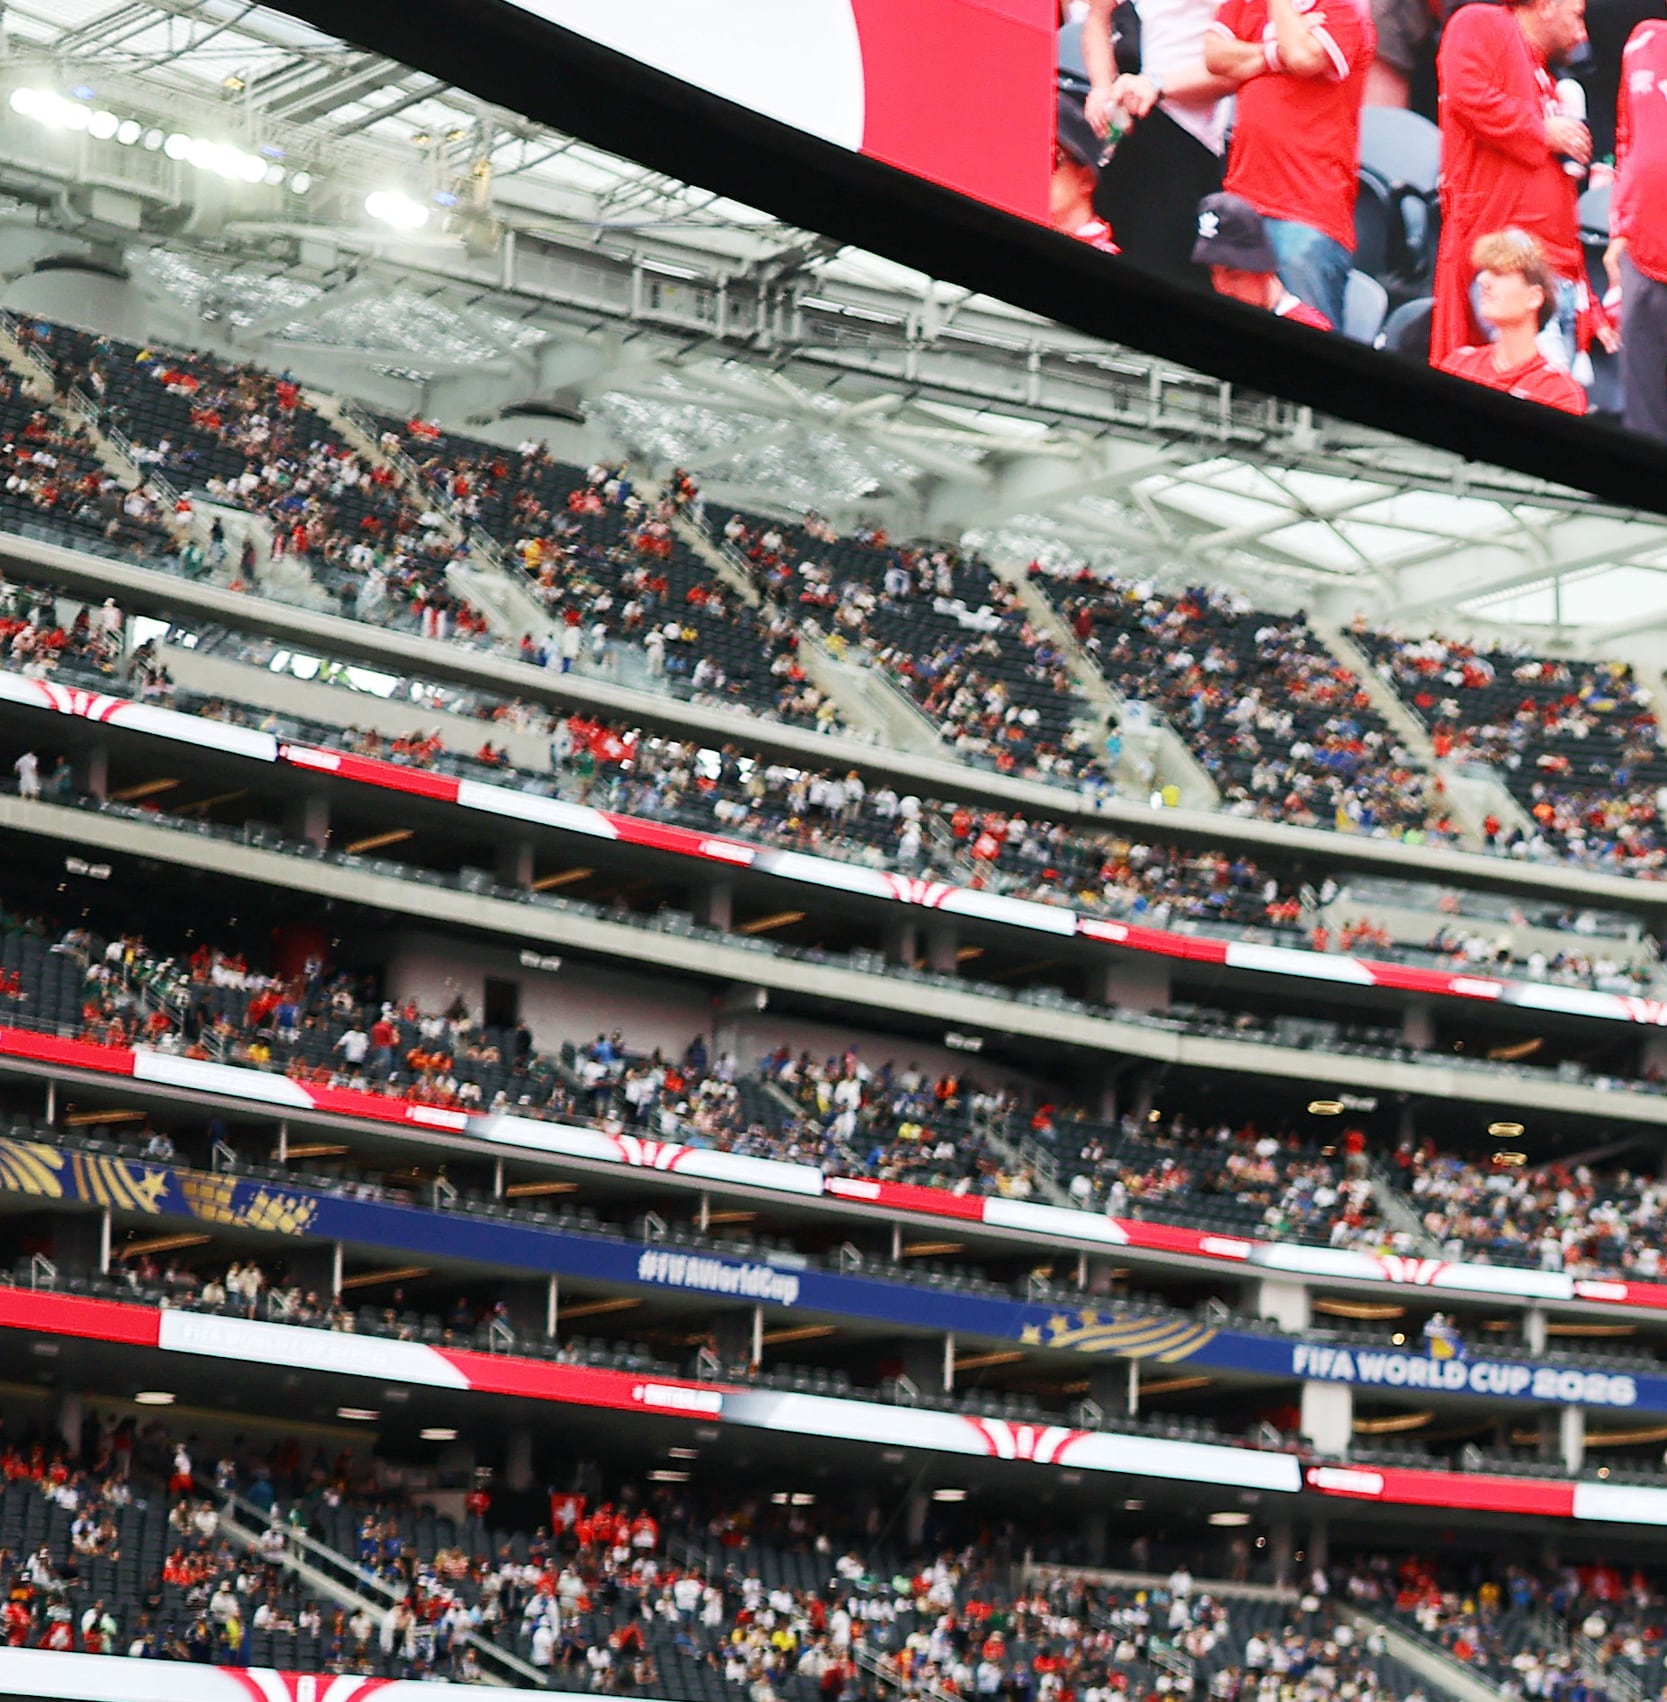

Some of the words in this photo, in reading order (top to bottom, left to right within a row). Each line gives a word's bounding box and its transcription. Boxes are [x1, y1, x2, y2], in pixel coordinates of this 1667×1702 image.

[637, 1249, 799, 1307] #FIFAWorldCup
[1292, 1343, 1355, 1381] FIFA
[1355, 1351, 1468, 1390] WORLD
[1468, 1362, 1531, 1395] CUP
[1531, 1367, 1637, 1406] 2026
